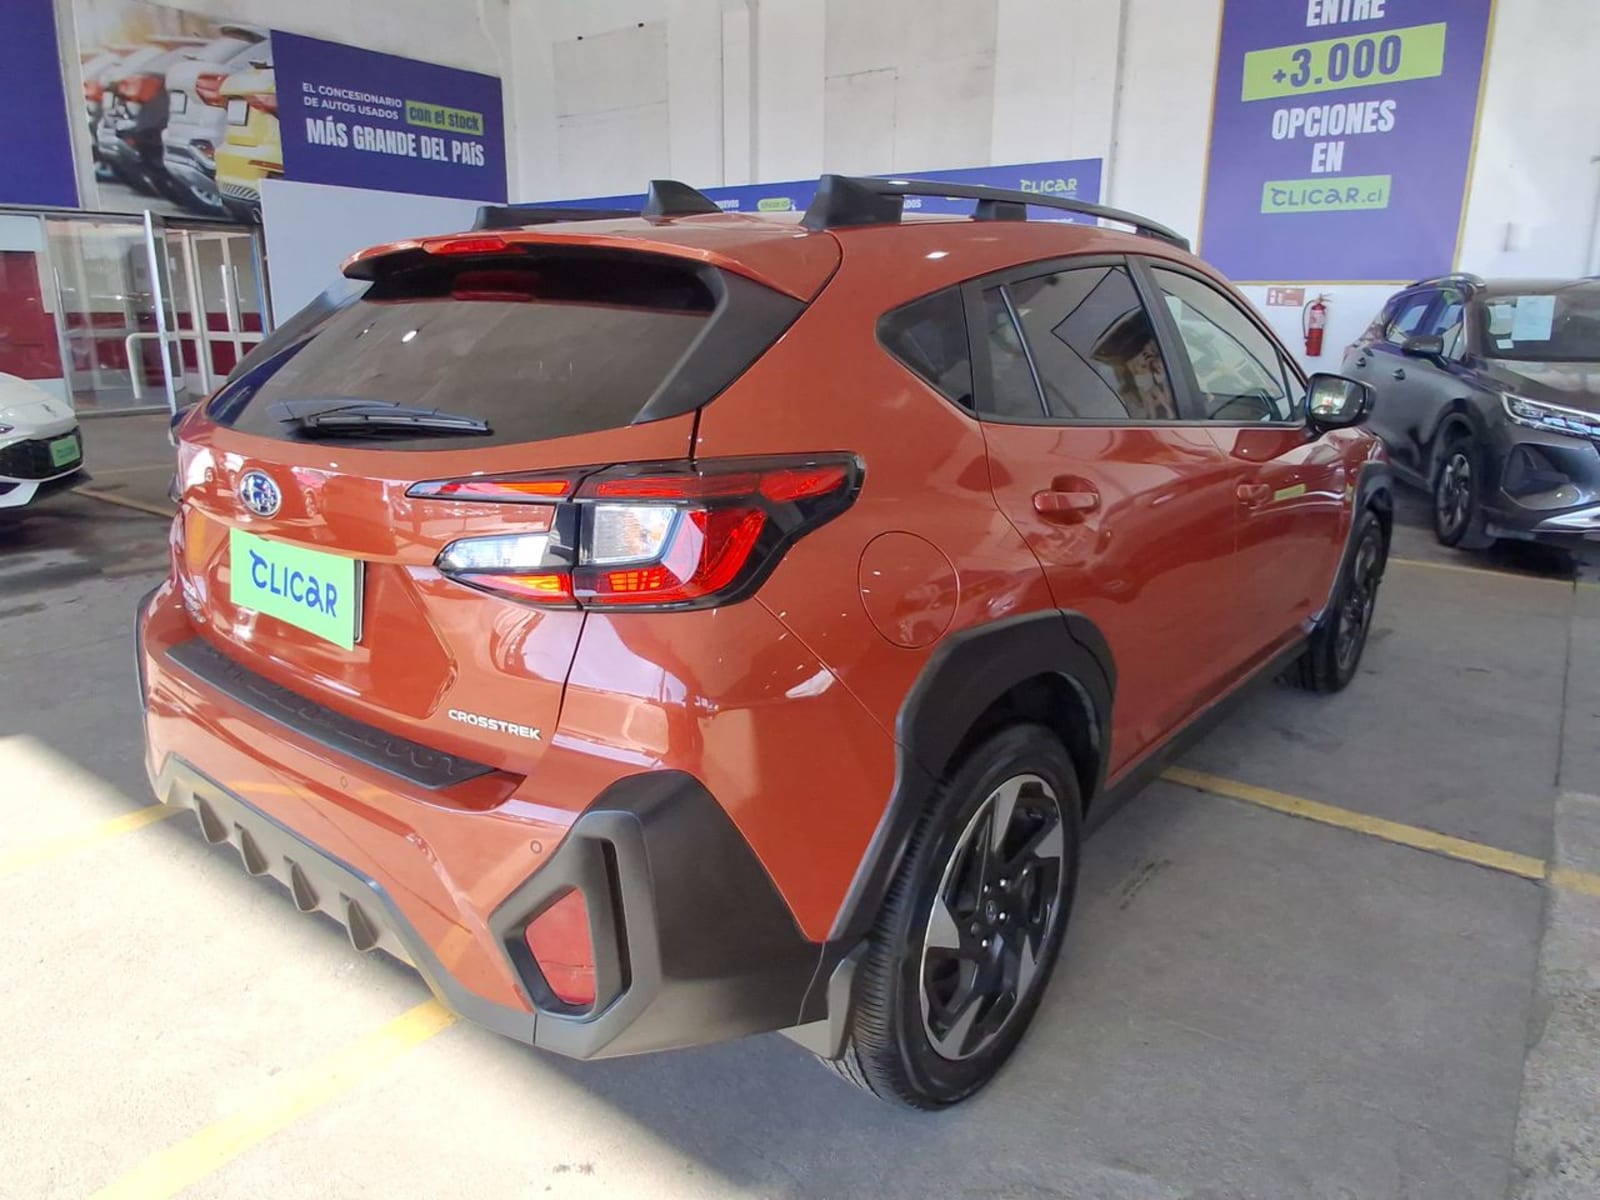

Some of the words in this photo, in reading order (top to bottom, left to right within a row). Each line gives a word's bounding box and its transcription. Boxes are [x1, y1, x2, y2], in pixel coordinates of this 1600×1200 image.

[1272, 34, 1402, 88] +3.000
[302, 82, 316, 93] EL
[318, 85, 403, 108] CONCESIONARIO
[304, 96, 319, 107] DE
[321, 99, 356, 113] AUTOS
[358, 105, 399, 120] USADOS
[409, 106, 432, 124] con
[434, 109, 445, 125] el
[448, 113, 480, 131] stock
[1271, 100, 1397, 139] OPCIONES
[306, 115, 348, 148] MÁS
[353, 125, 417, 157] GRANDE
[420, 135, 449, 161] DEL
[1311, 141, 1344, 173] EN
[448, 709, 542, 741] CROSSTREK
